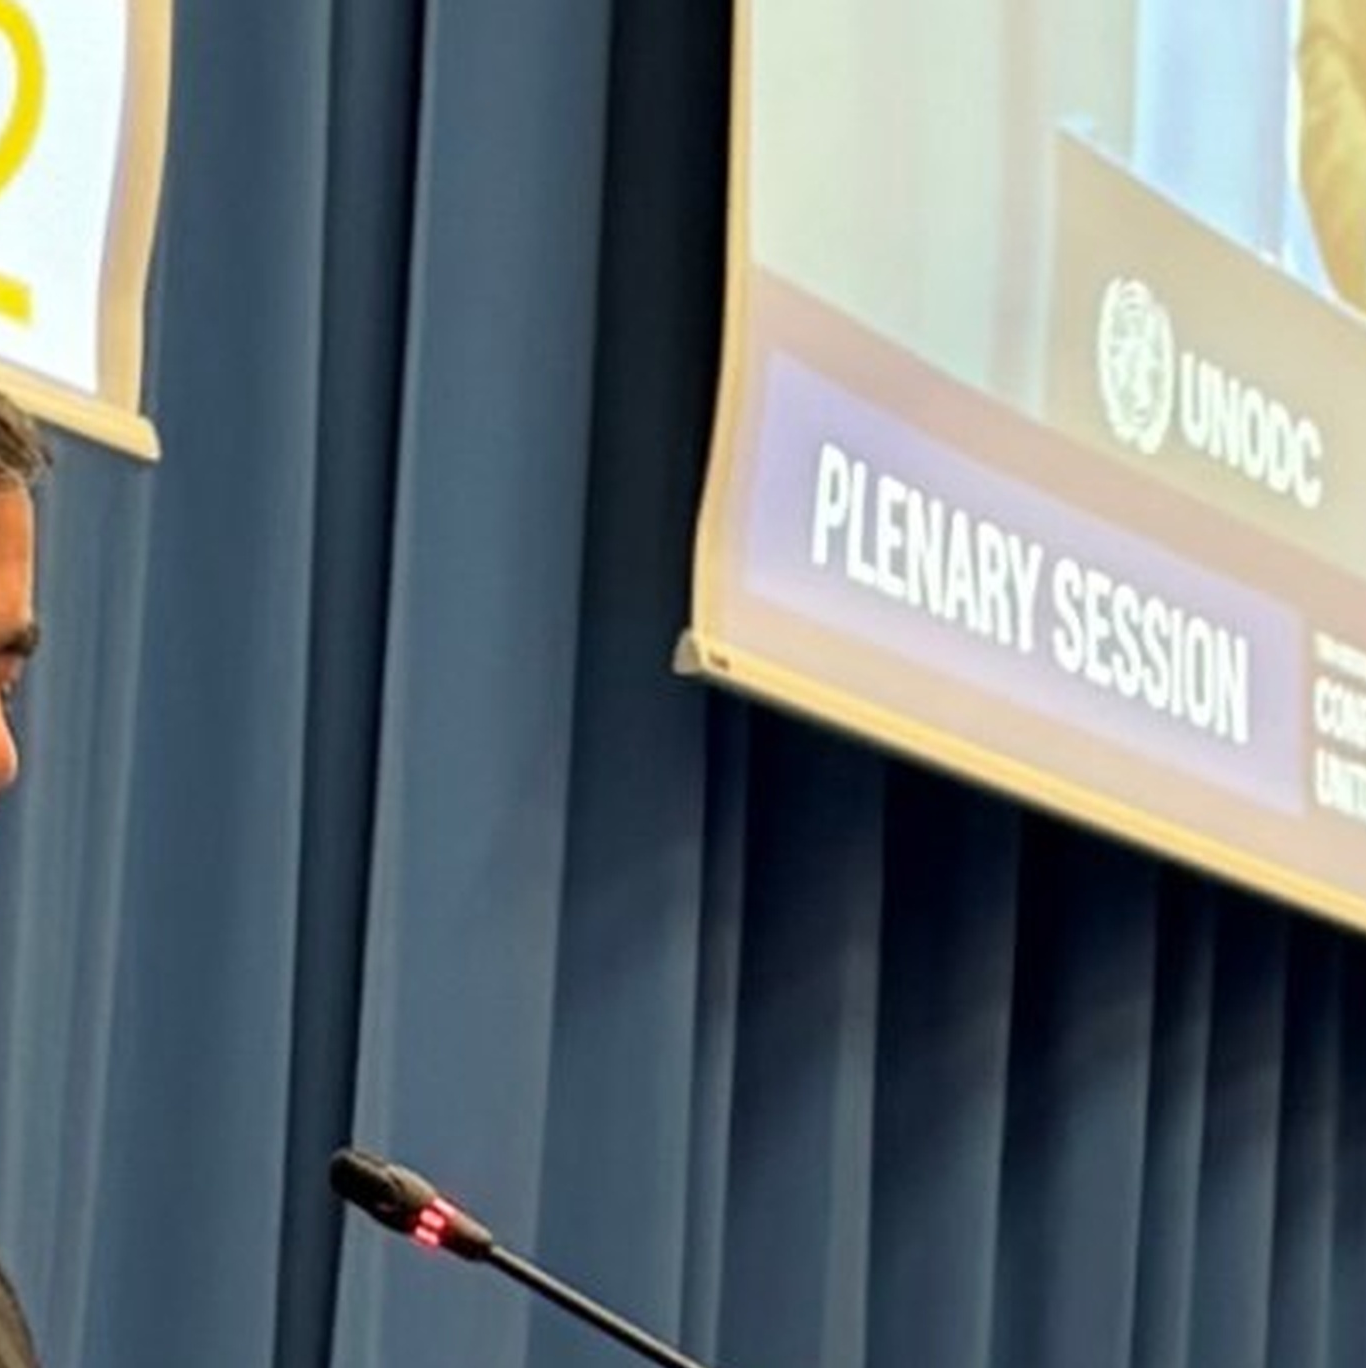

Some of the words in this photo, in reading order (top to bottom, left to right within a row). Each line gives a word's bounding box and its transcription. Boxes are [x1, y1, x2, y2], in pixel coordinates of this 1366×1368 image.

[1179, 351, 1323, 510] UNODC
[811, 442, 1045, 656] PLENARY
[1050, 551, 1250, 745] SESSION
